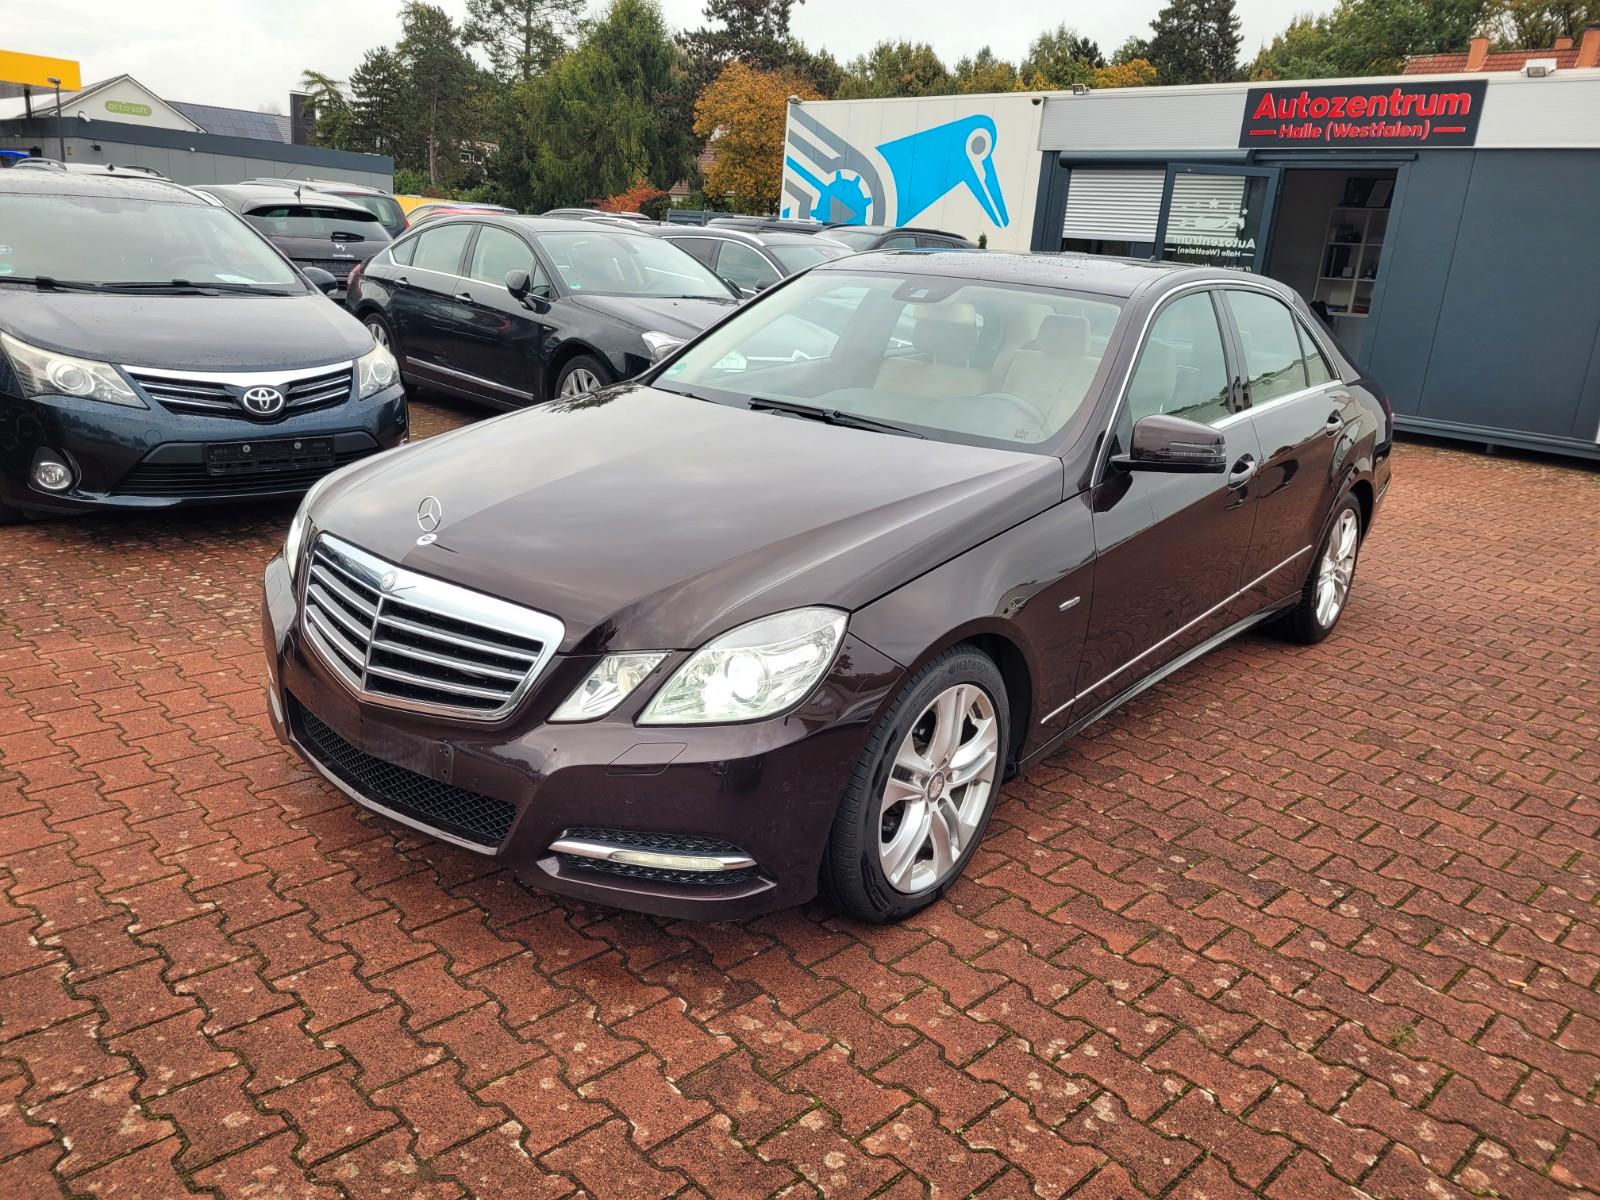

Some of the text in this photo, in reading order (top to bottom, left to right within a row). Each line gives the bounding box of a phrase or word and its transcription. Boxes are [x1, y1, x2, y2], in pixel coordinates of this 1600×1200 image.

[1252, 88, 1472, 119] Autozentrum
[1279, 119, 1431, 141] Halle (Westfalen)
